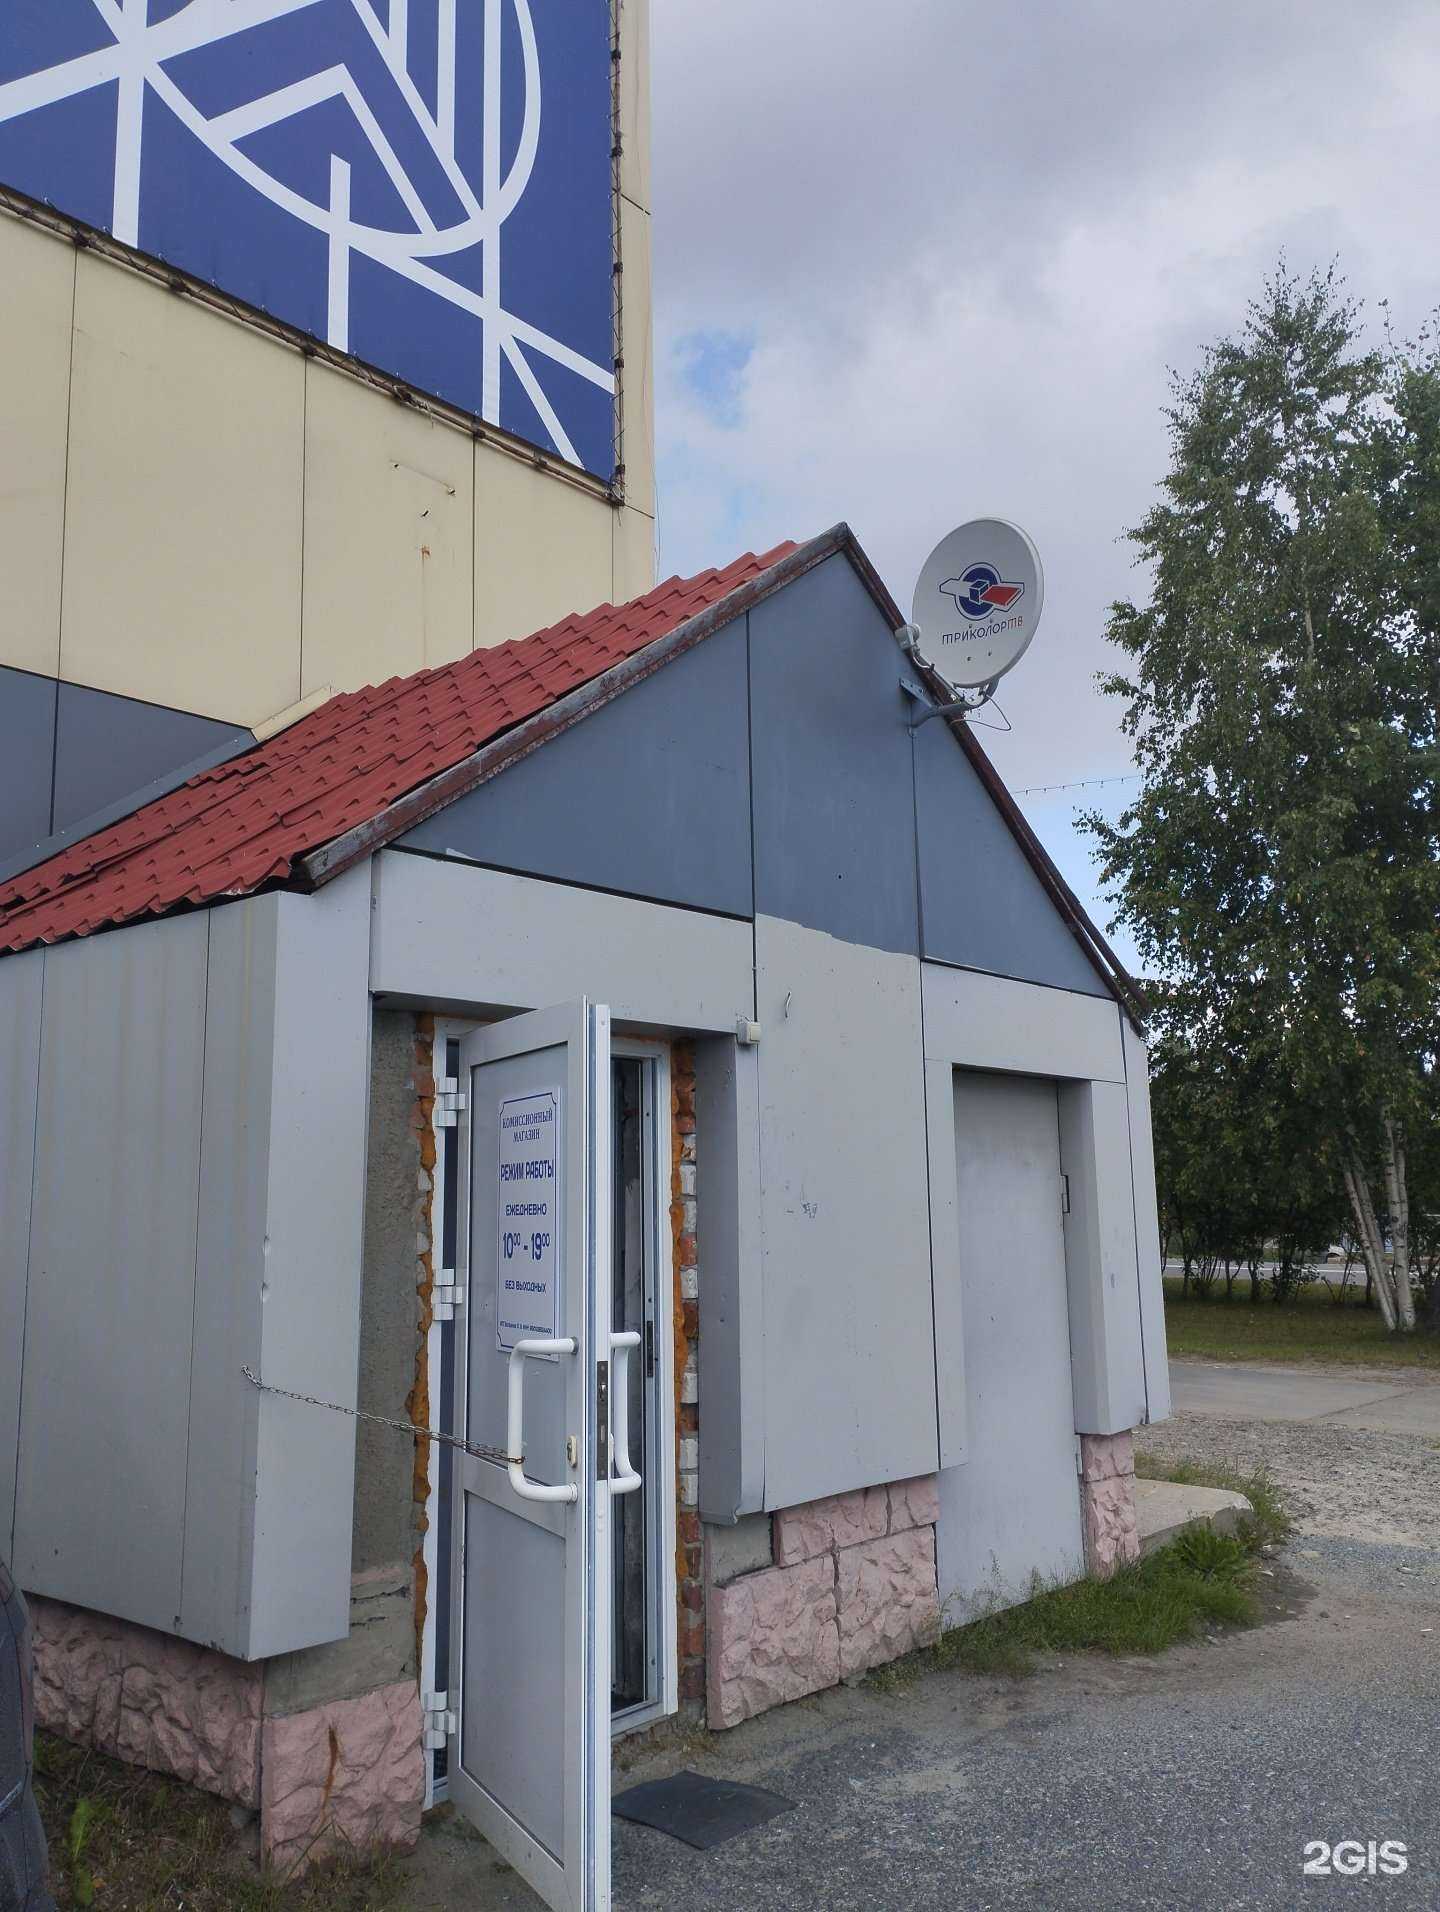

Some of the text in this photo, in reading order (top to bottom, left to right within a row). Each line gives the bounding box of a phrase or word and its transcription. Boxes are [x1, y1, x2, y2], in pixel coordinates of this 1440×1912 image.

[502, 1107, 553, 1129] КОМИССИОННЫЙ
[513, 1128, 541, 1142] МАГАЗИН
[500, 1159, 554, 1182] РЕЖИМ РАБОТЫ
[505, 1203, 547, 1216] ЕЖЕДНЕВНО
[504, 1279, 547, 1294] БЕЗ ВЫХОДНЫХ
